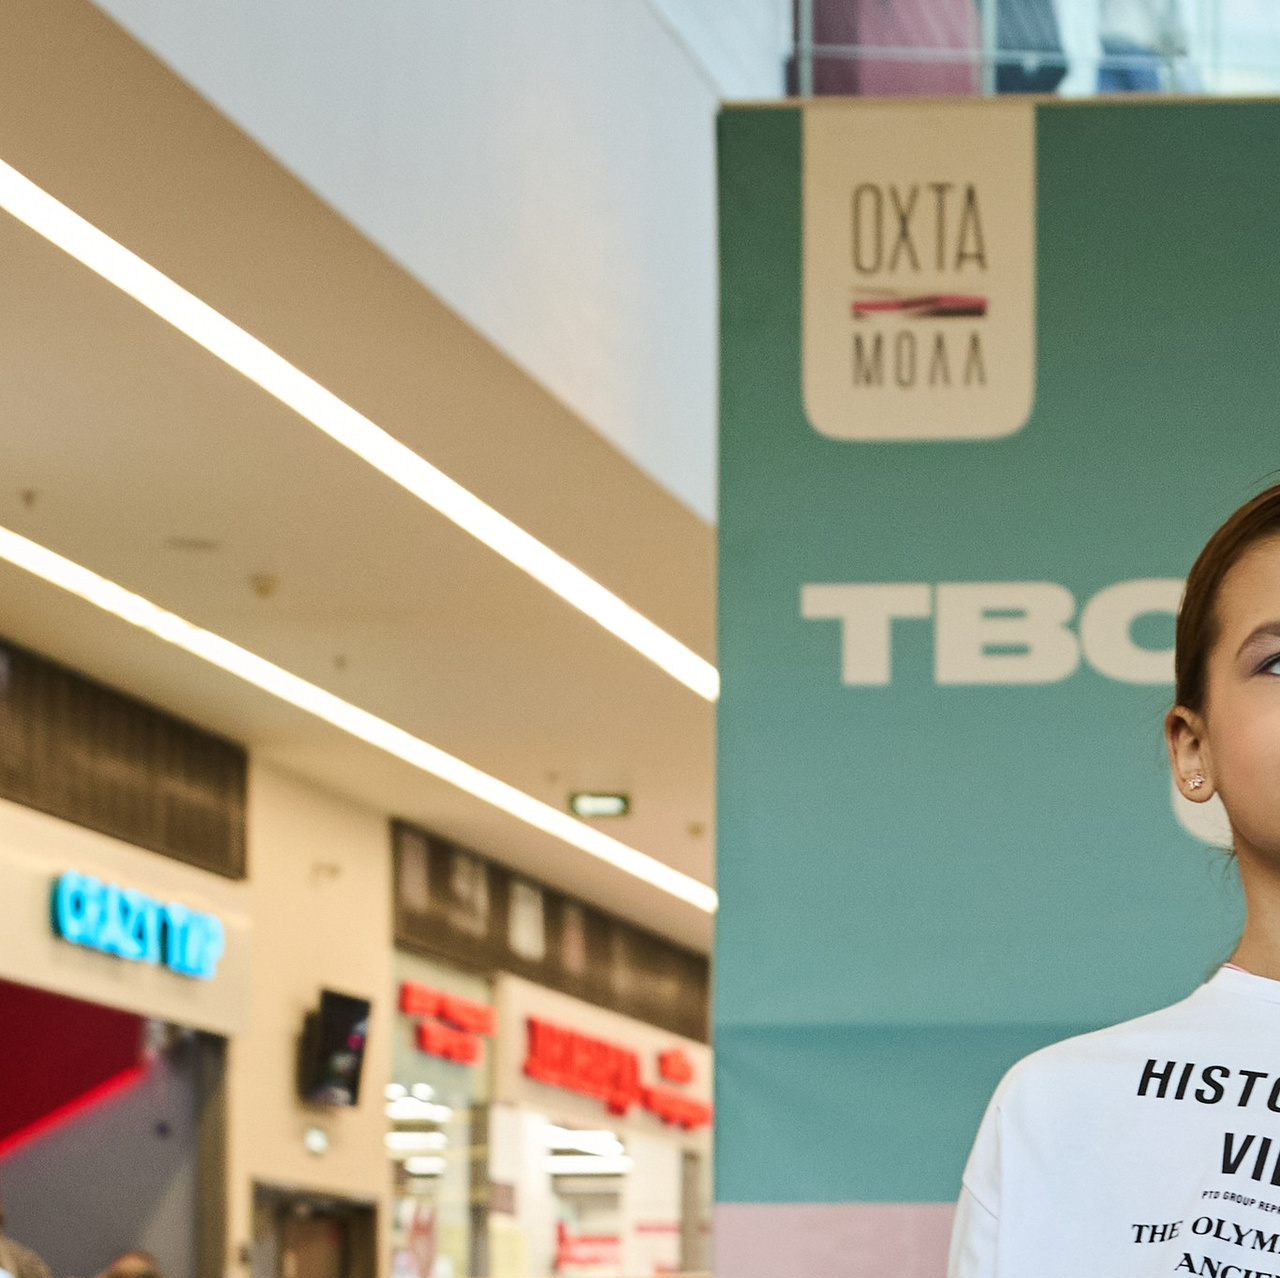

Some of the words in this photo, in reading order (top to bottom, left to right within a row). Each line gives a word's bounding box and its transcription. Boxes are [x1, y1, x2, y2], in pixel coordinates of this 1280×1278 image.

[850, 182, 989, 274] ОХТА
[800, 578, 1184, 685] ТВО
[1223, 1191, 1256, 1207] GROUP
[1131, 1219, 1184, 1244] THE
